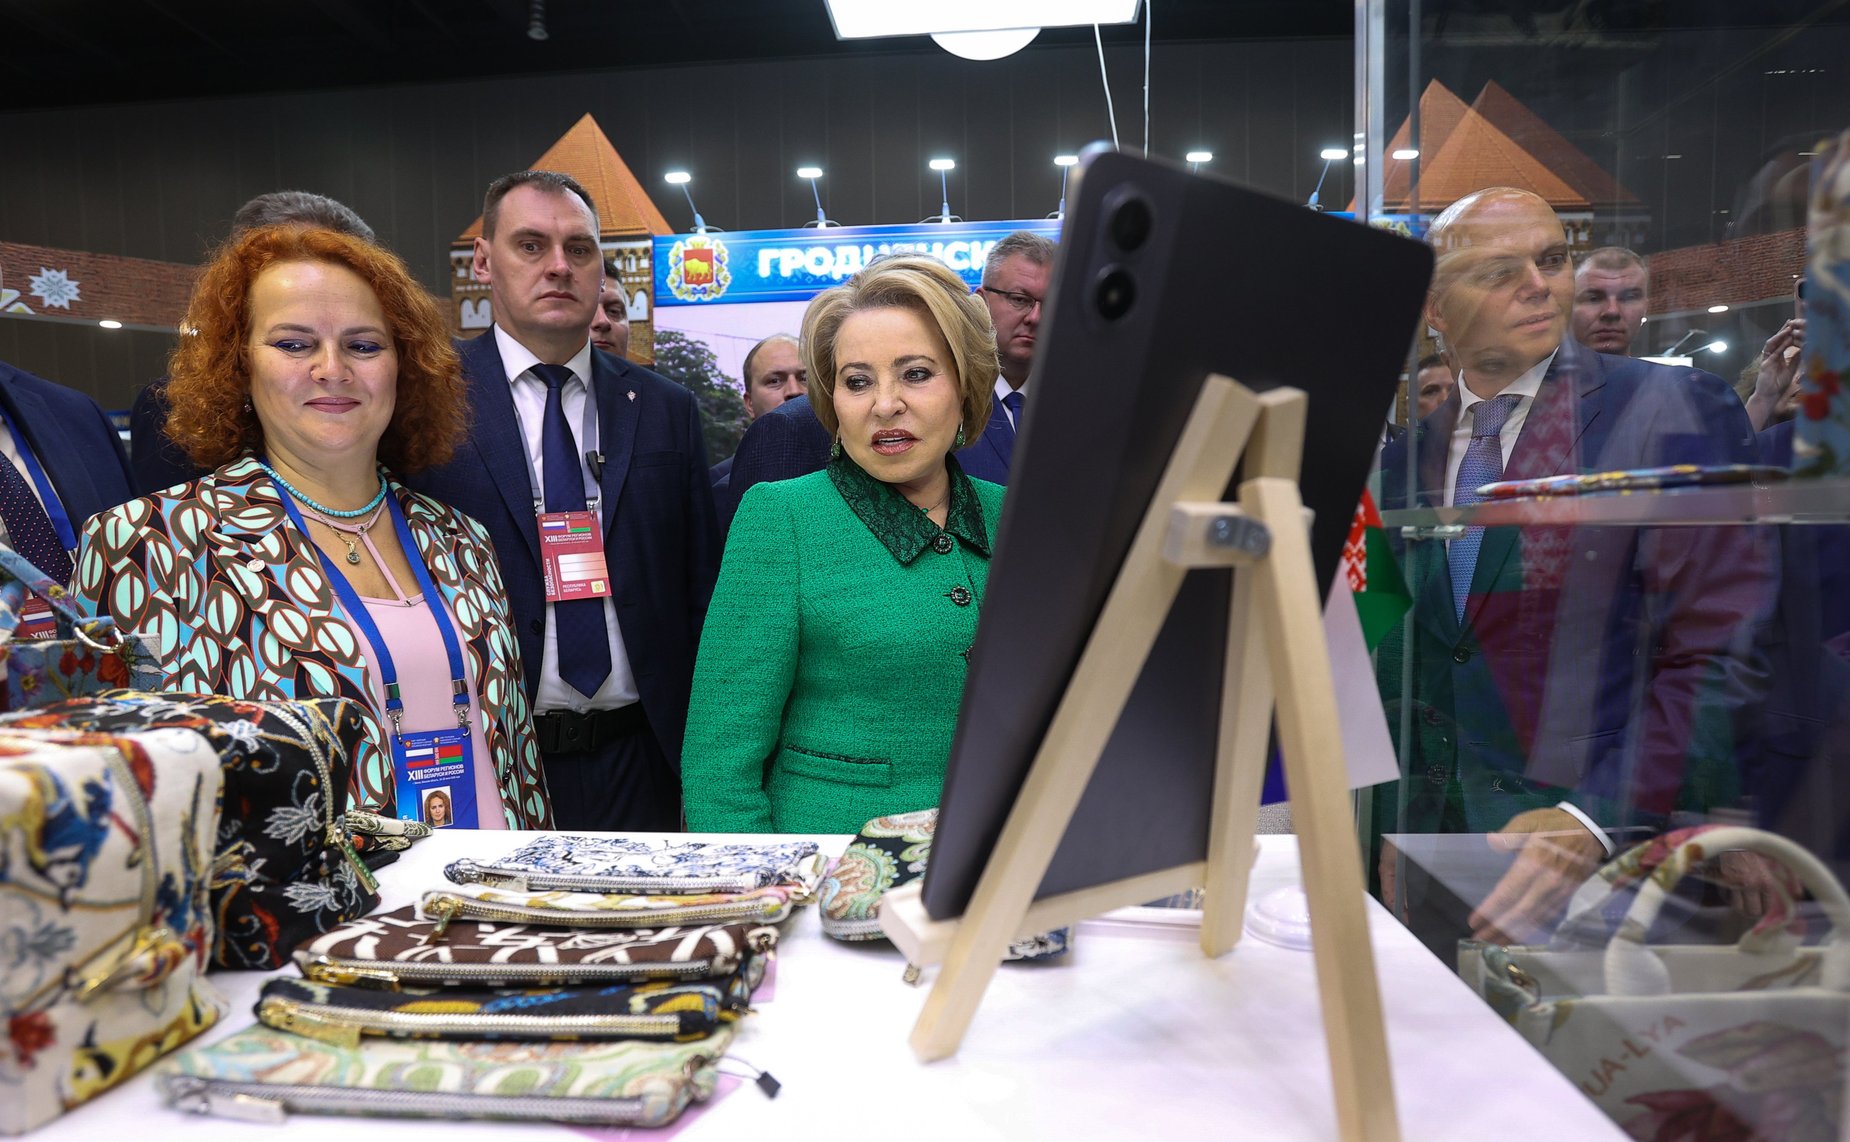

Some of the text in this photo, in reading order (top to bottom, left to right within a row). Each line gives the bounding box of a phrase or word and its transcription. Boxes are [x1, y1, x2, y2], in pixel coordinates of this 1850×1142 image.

[544, 535, 558, 543] XIII
[407, 769, 424, 782] XIII
[424, 771, 444, 779] БЕЛАРУСИ
